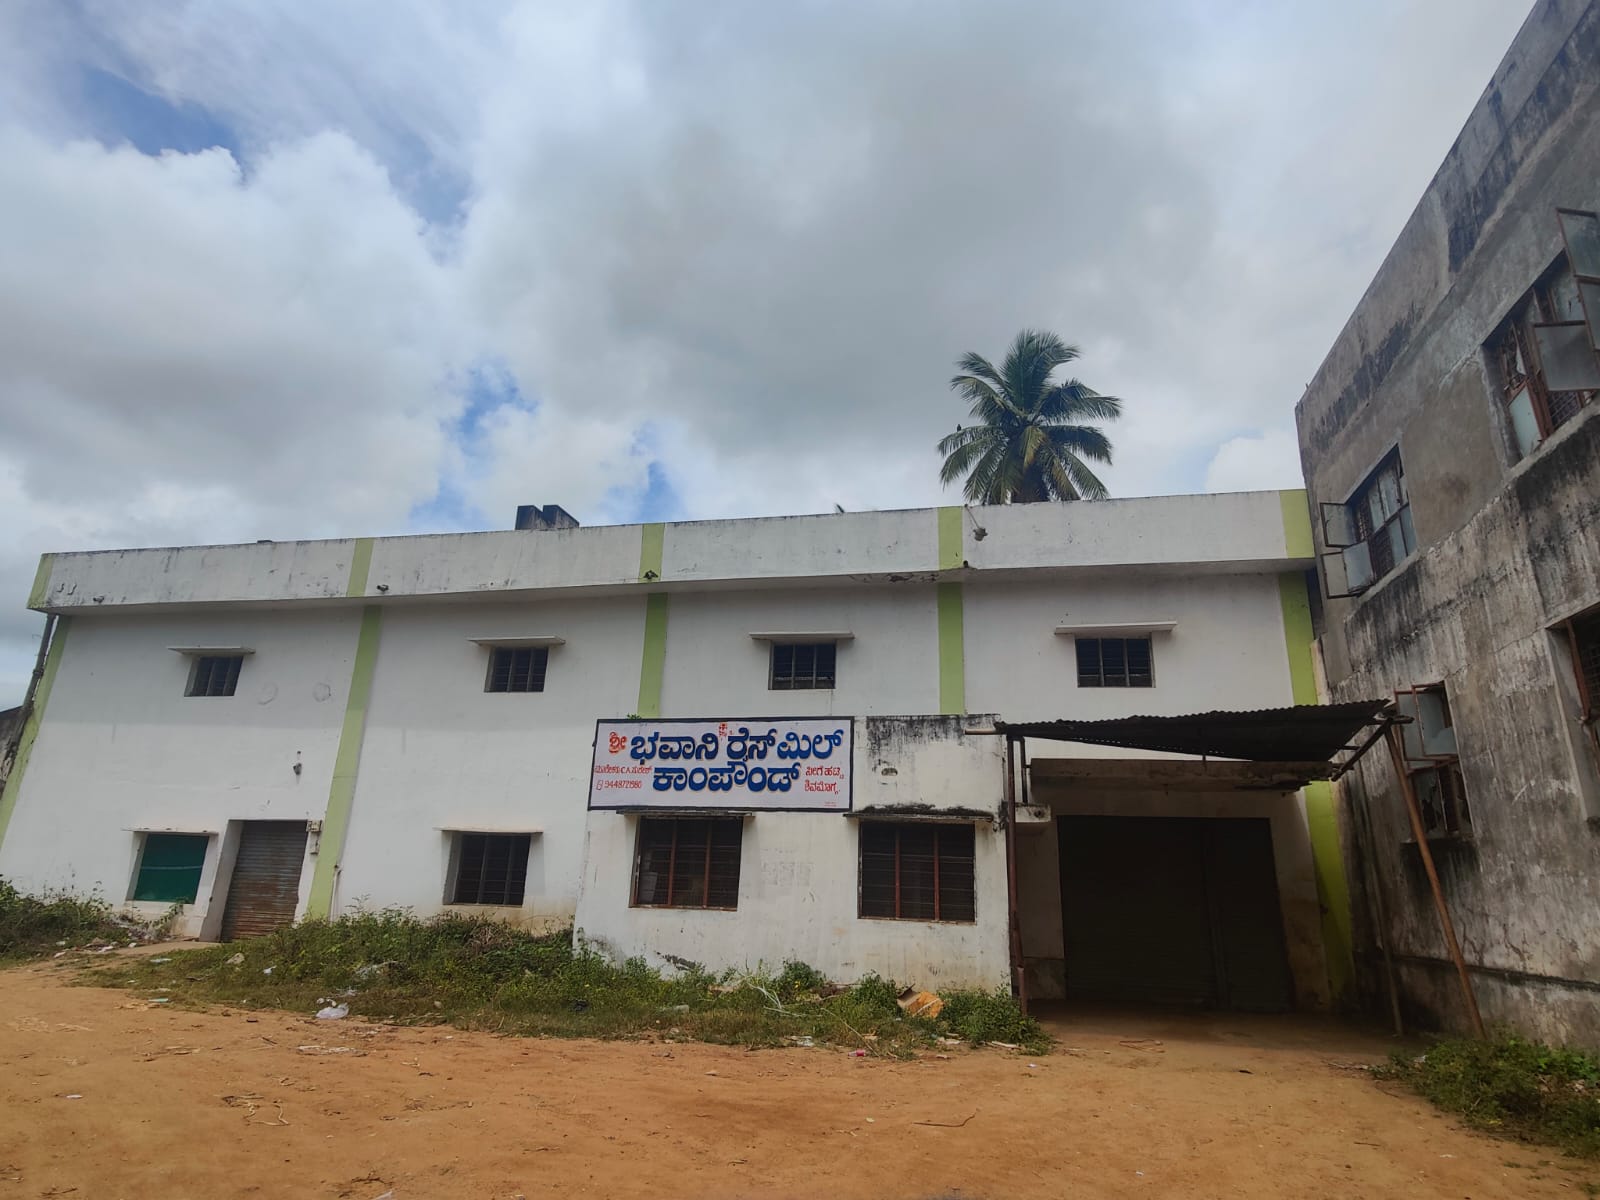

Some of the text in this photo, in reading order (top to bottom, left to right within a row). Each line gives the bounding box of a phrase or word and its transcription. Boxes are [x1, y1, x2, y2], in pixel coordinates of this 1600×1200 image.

[608, 727, 844, 765] ಶ್ರೀ ಭವಾನಿ ರೈಸ್ ಮಿಲ್
[652, 761, 801, 792] ಕಾಂಪೌಂಡ್
